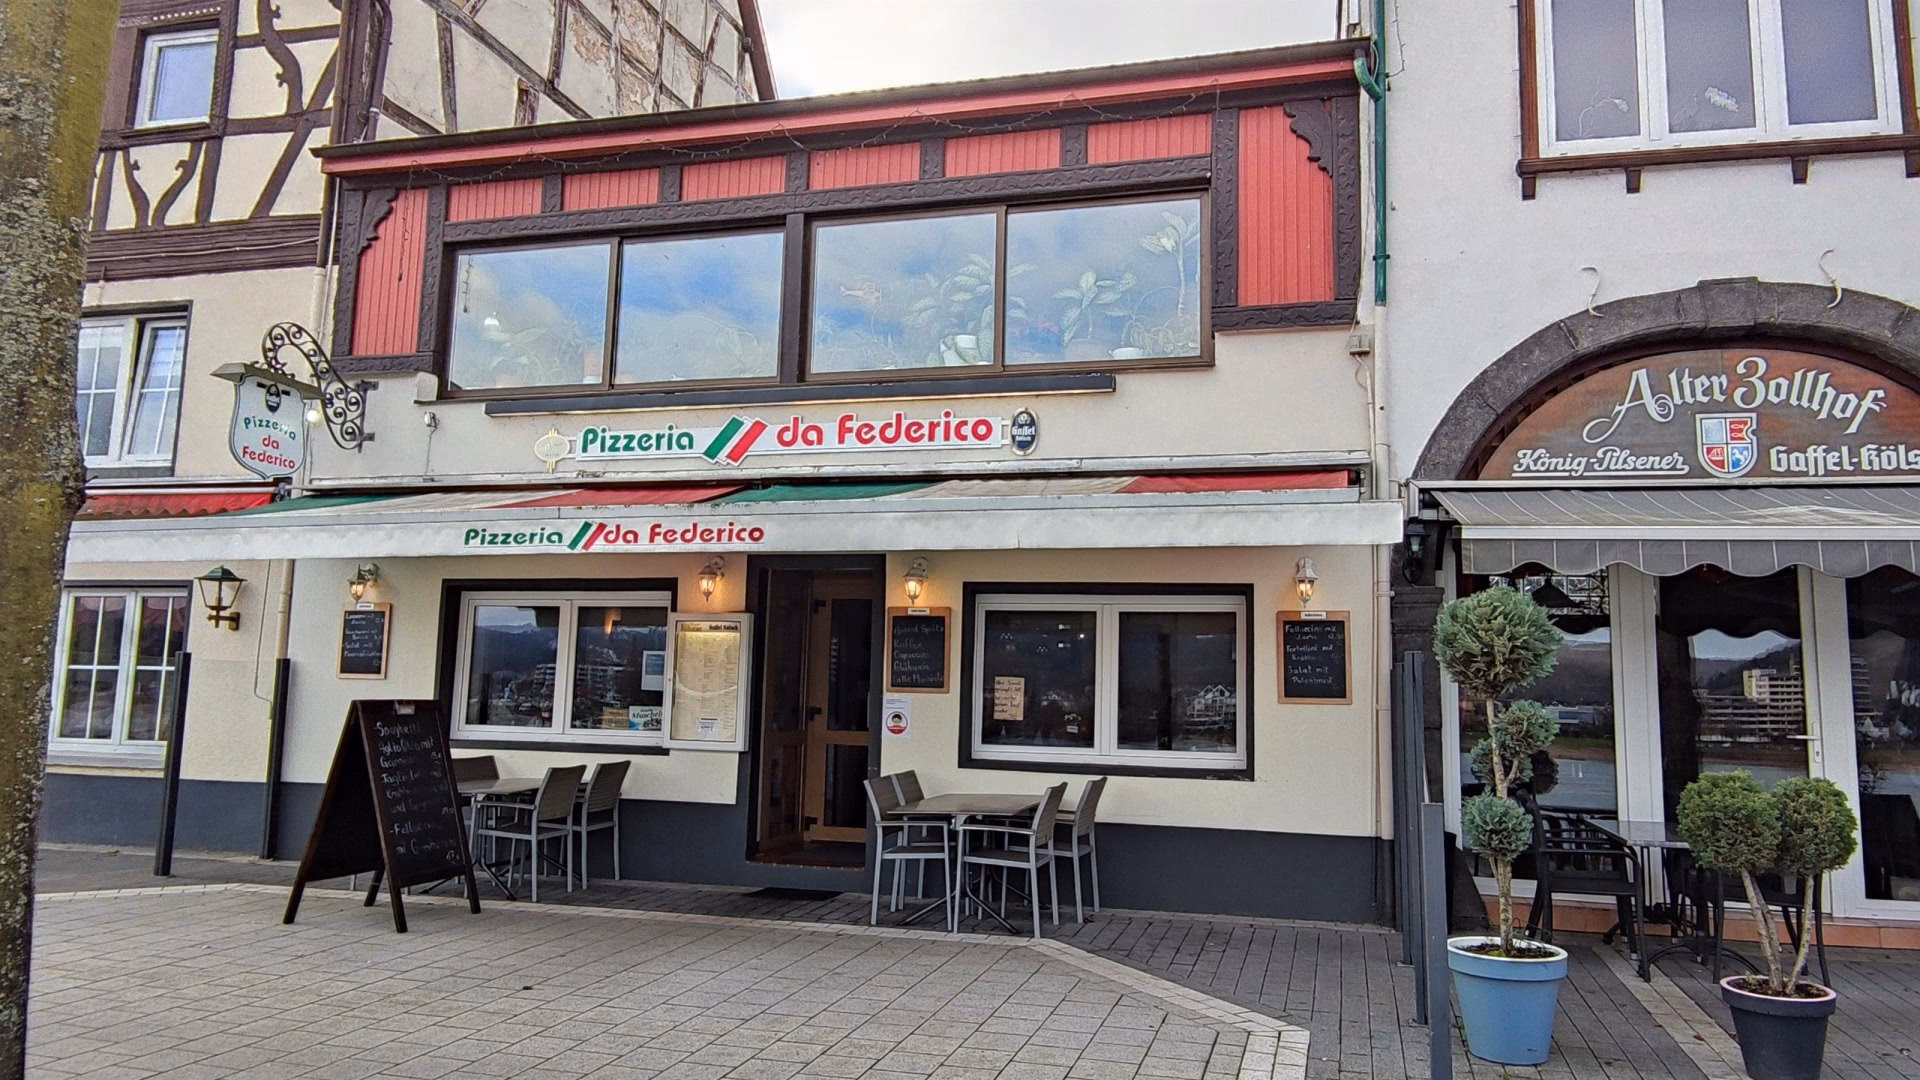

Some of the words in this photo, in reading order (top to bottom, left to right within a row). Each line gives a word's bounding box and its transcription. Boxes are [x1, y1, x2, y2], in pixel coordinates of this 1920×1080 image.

[1582, 366, 1728, 444] Alter
[1733, 357, 1888, 434] Zollhof
[263, 434, 279, 450] da
[581, 425, 694, 453] Pizzeria
[776, 416, 824, 447] da
[837, 410, 994, 445] Federico
[1012, 425, 1036, 436] Gaffel
[243, 446, 296, 470] Federico
[1512, 446, 1690, 477] König-Pilsener
[464, 527, 563, 546] Pizzeria
[603, 524, 639, 544] da
[648, 522, 765, 544] Federico
[1288, 665, 1312, 674] Salat
